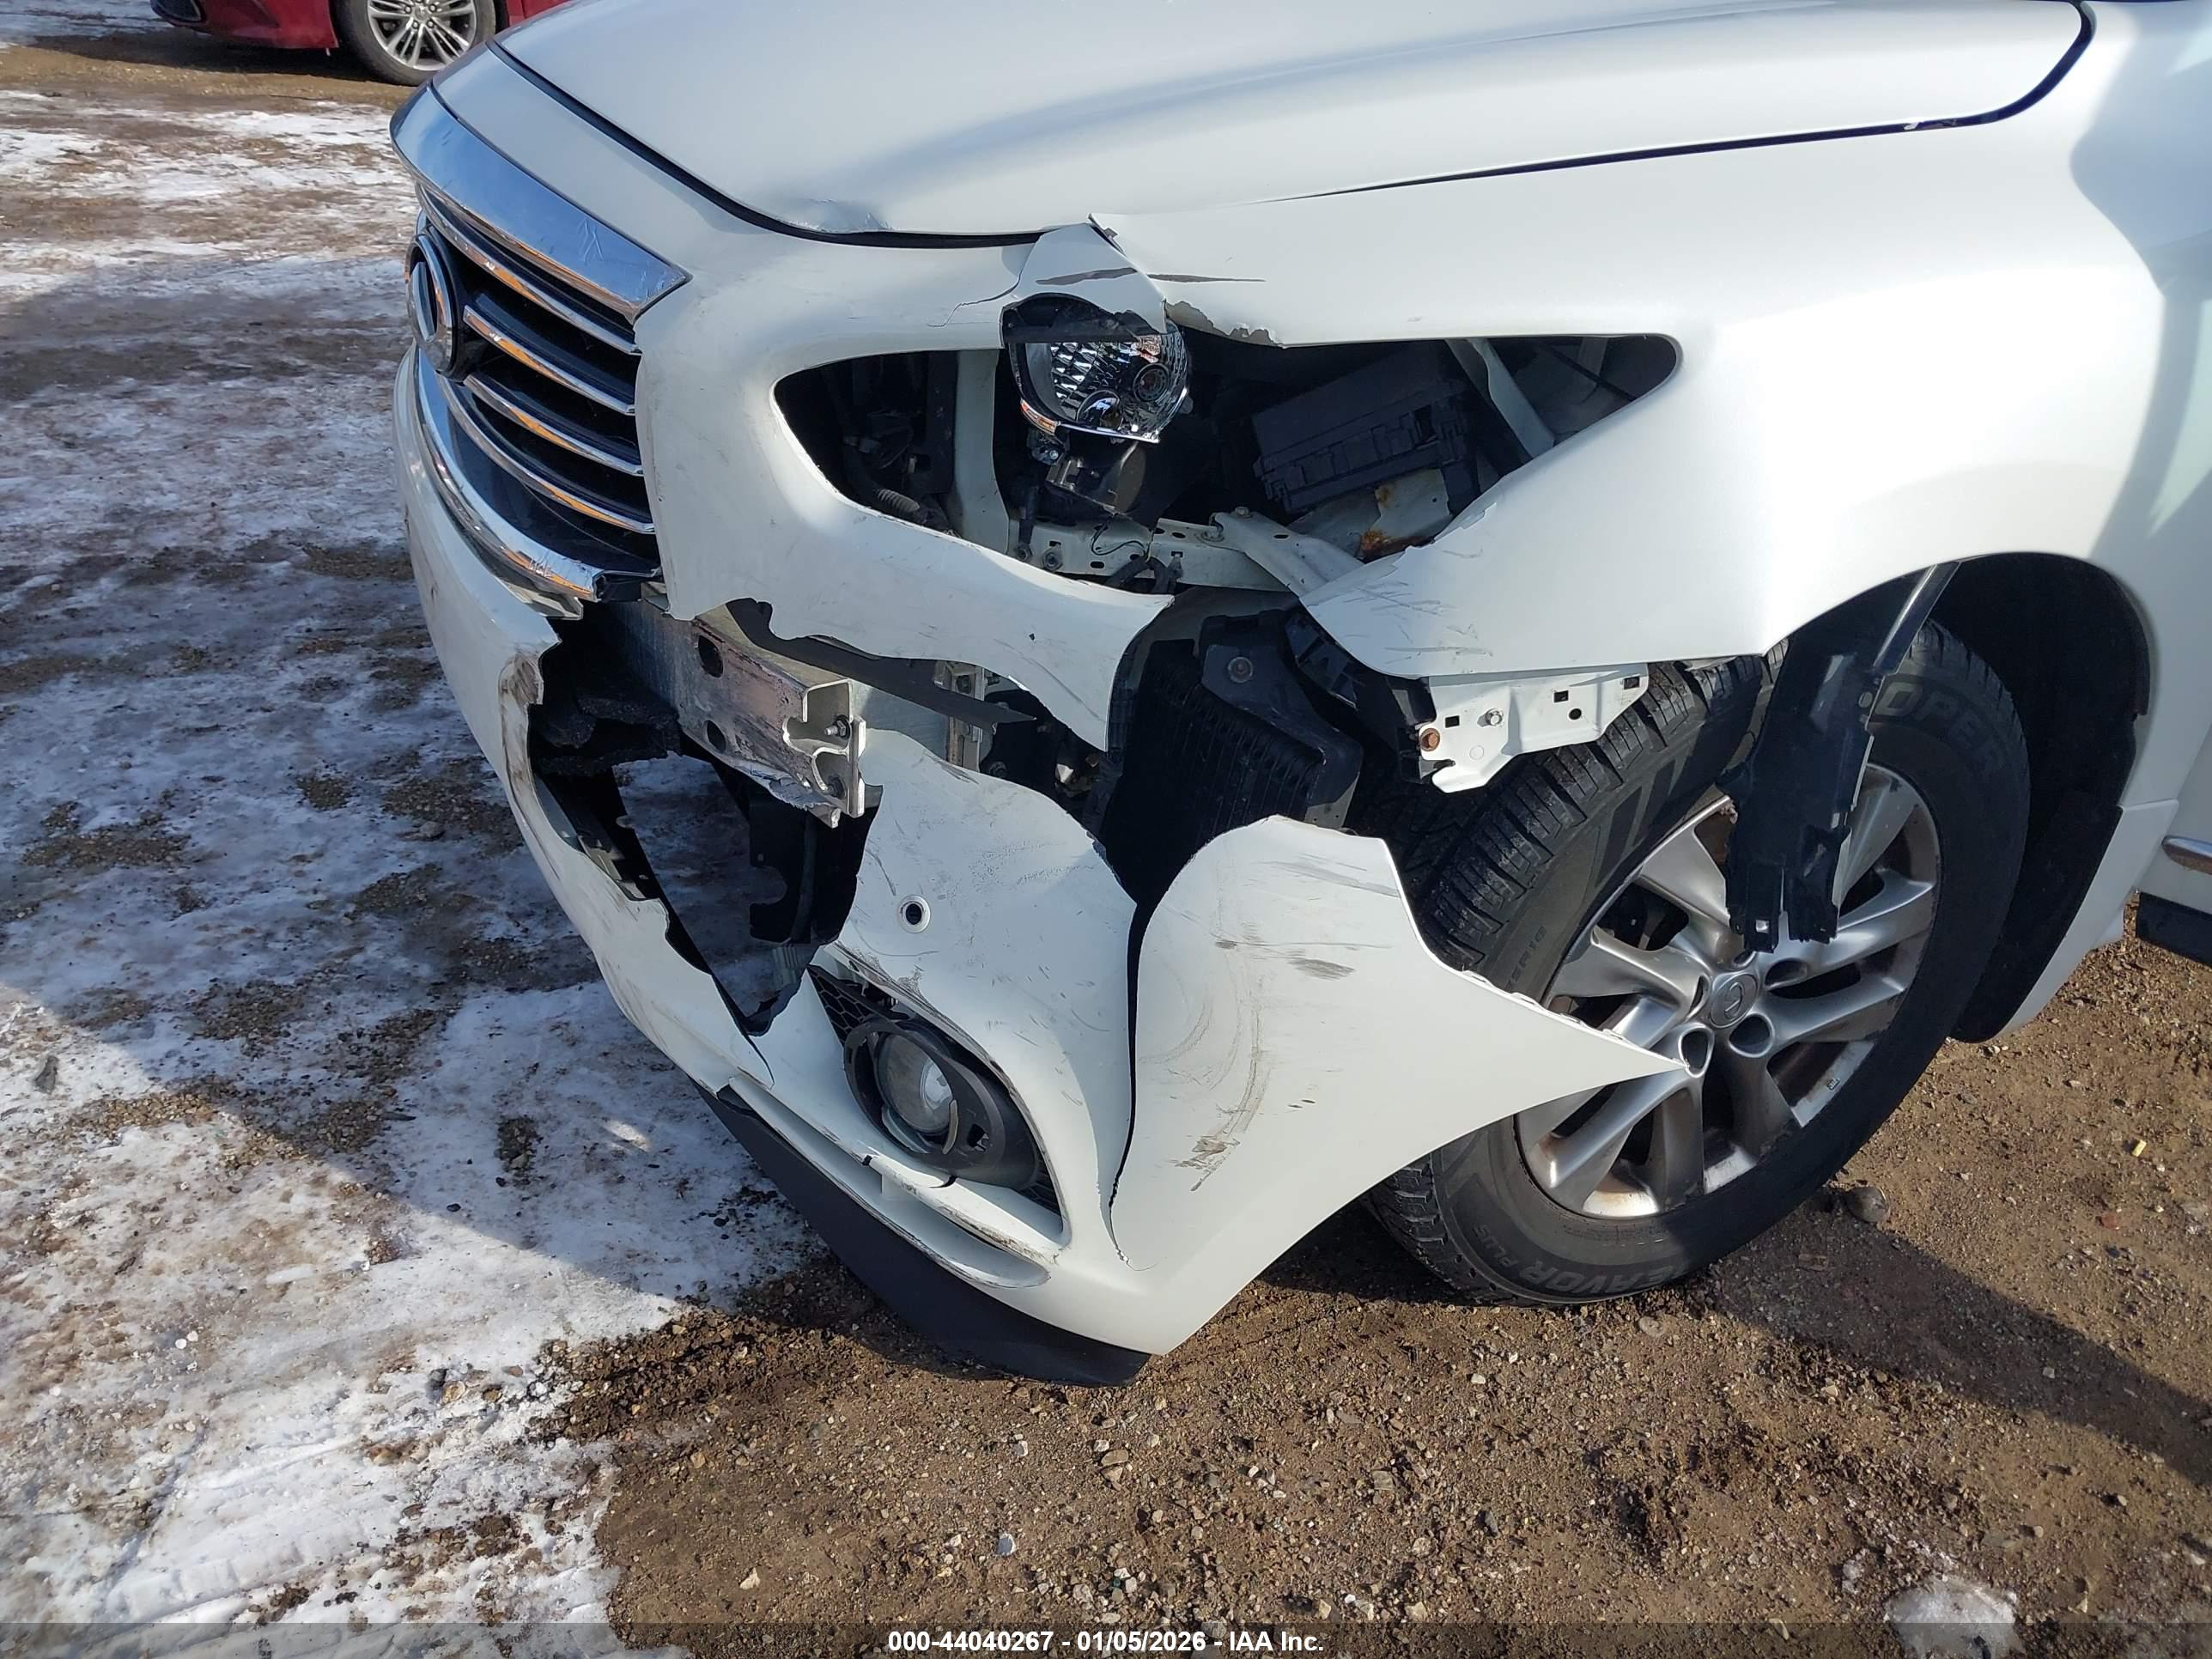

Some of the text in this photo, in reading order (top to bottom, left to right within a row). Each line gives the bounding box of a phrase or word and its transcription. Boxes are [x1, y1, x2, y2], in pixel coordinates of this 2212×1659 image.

[1874, 681, 2008, 773] OPER
[1472, 1224, 1519, 1268] PLUS
[1519, 1260, 1674, 1293] EAVOR
